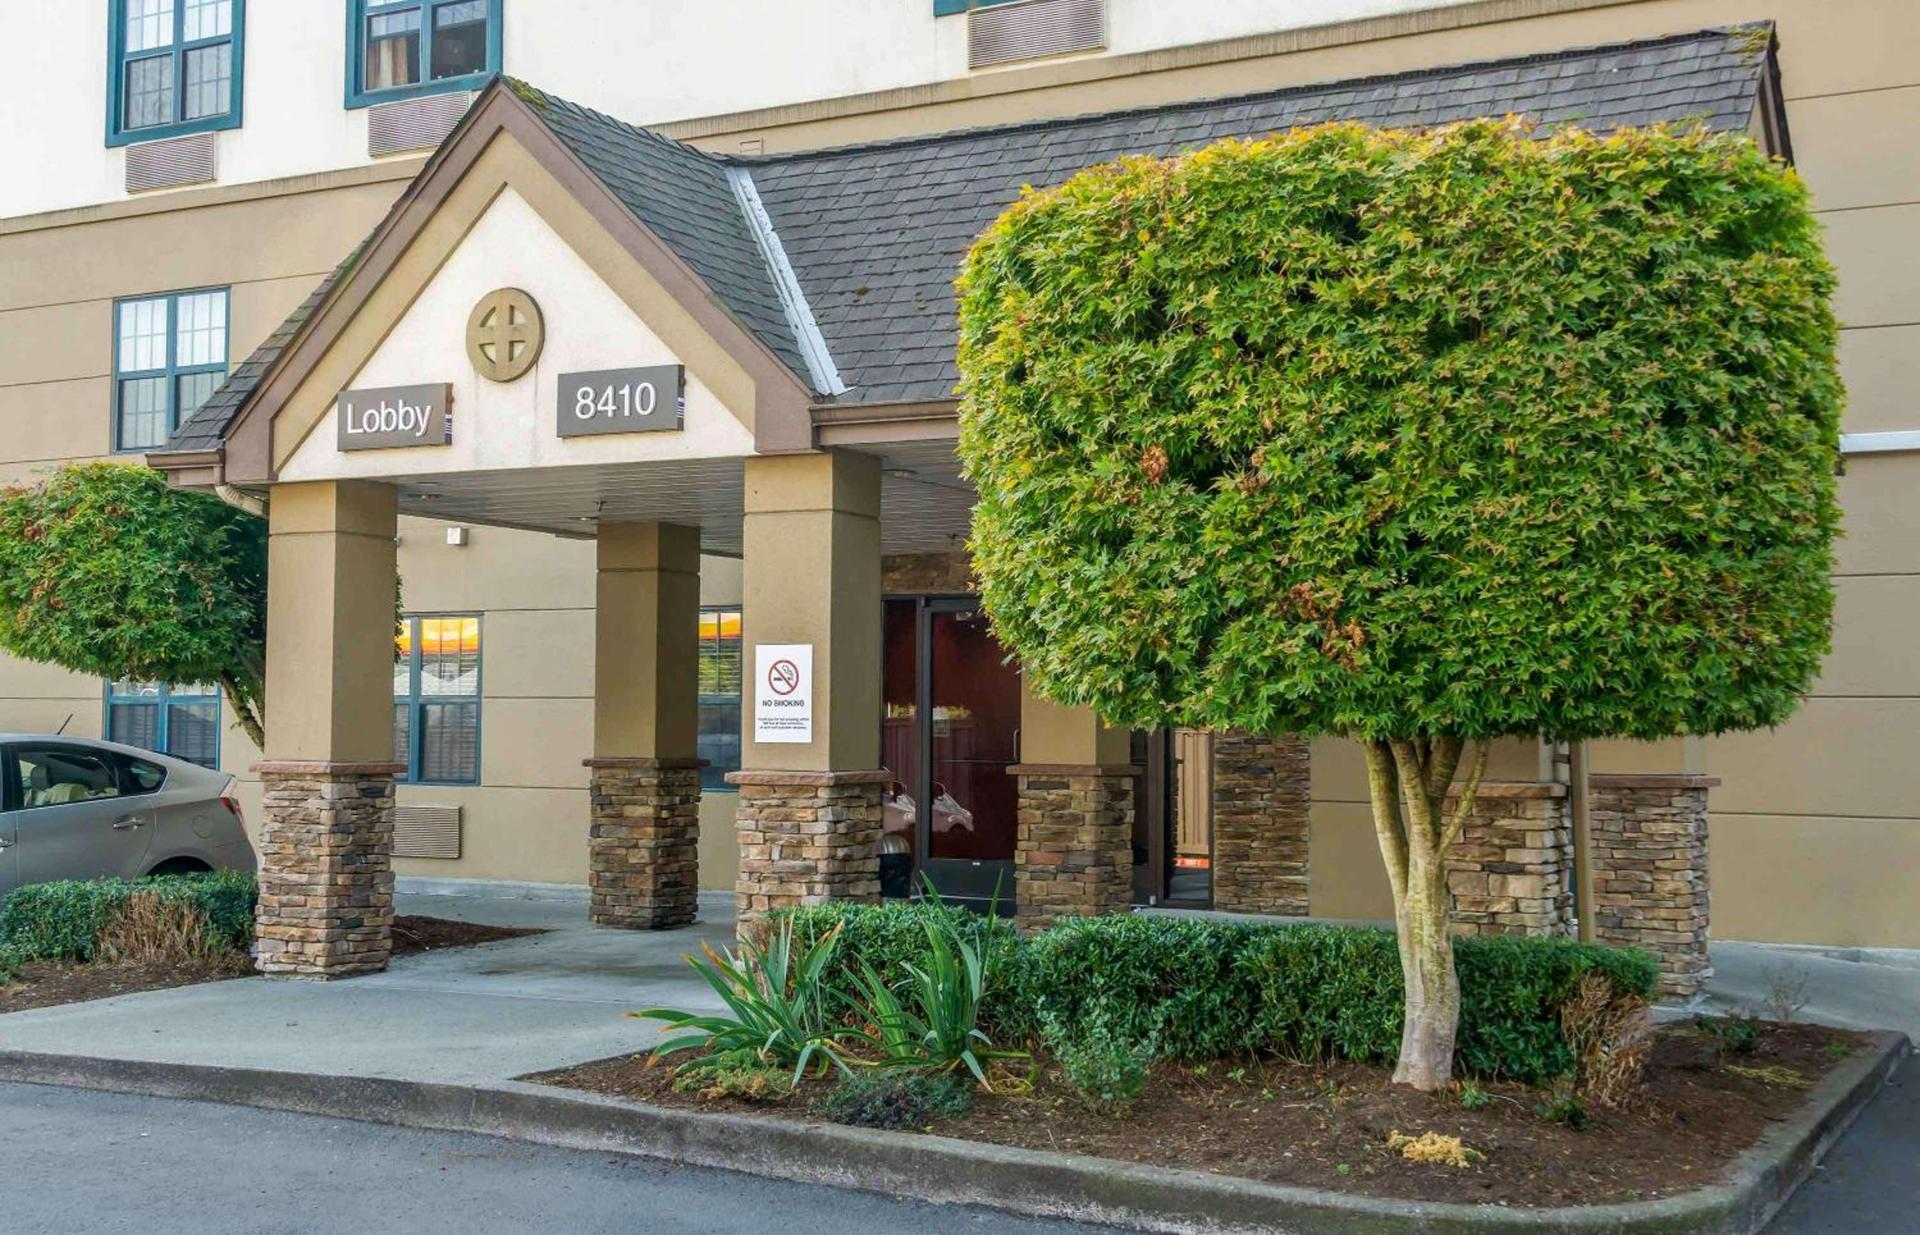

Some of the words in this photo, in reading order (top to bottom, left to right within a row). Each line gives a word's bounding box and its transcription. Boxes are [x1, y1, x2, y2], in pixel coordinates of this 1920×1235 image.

[346, 400, 432, 437] Lobby
[574, 382, 657, 419] 8410
[762, 699, 773, 707] NO
[774, 699, 805, 707] SMOKING
